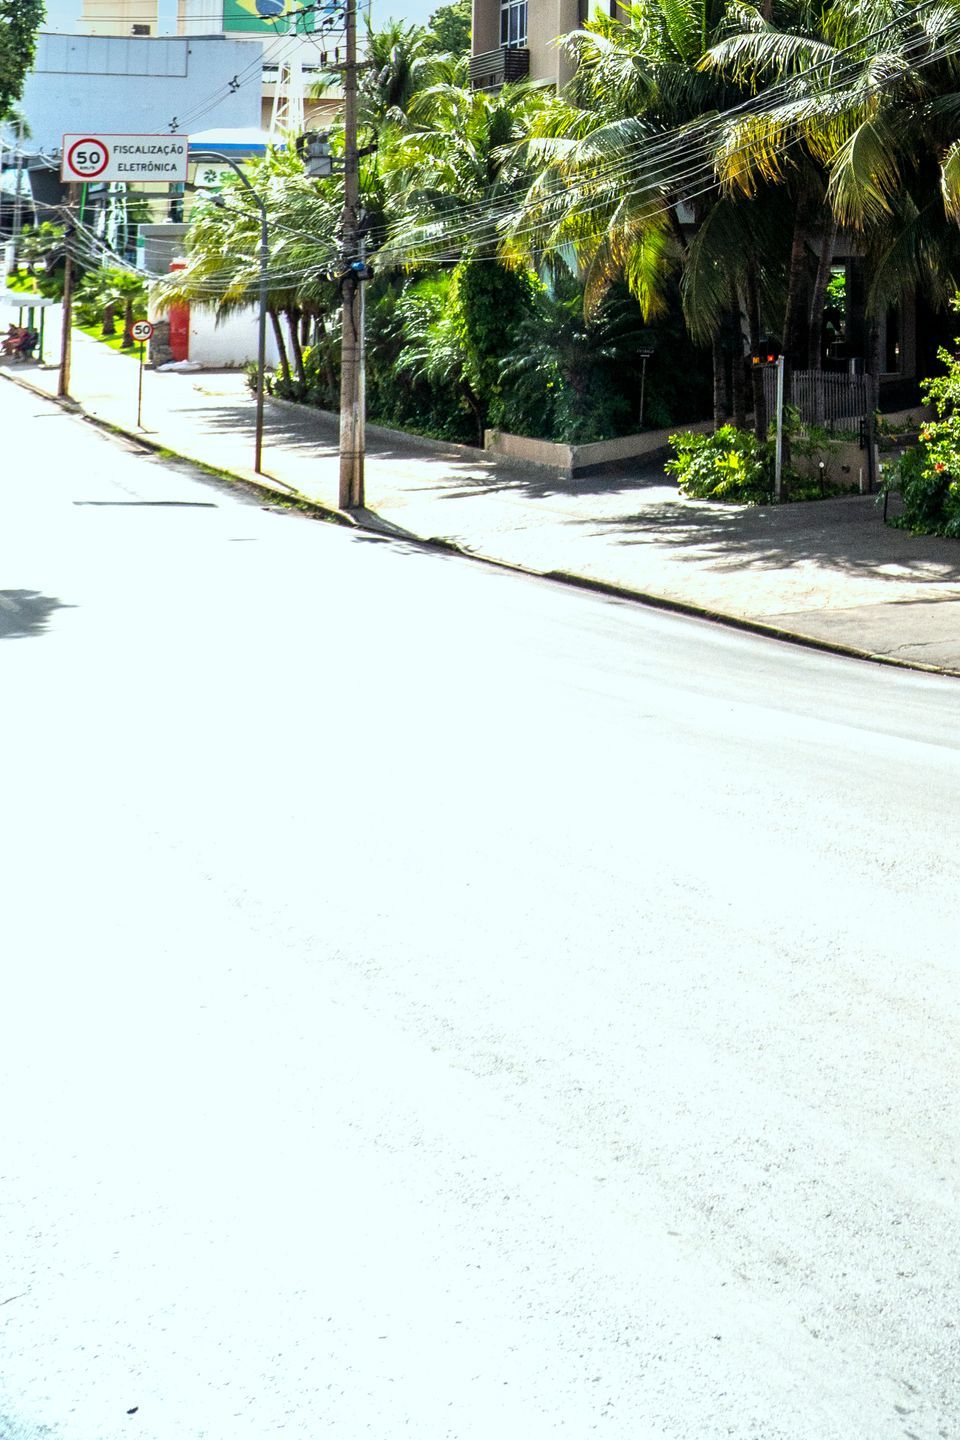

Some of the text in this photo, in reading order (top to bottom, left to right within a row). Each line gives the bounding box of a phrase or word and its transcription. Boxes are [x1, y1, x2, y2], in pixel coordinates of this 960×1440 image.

[113, 144, 184, 156] FISCALIZAÇÃO
[77, 151, 100, 164] 50
[135, 325, 150, 335] 50
